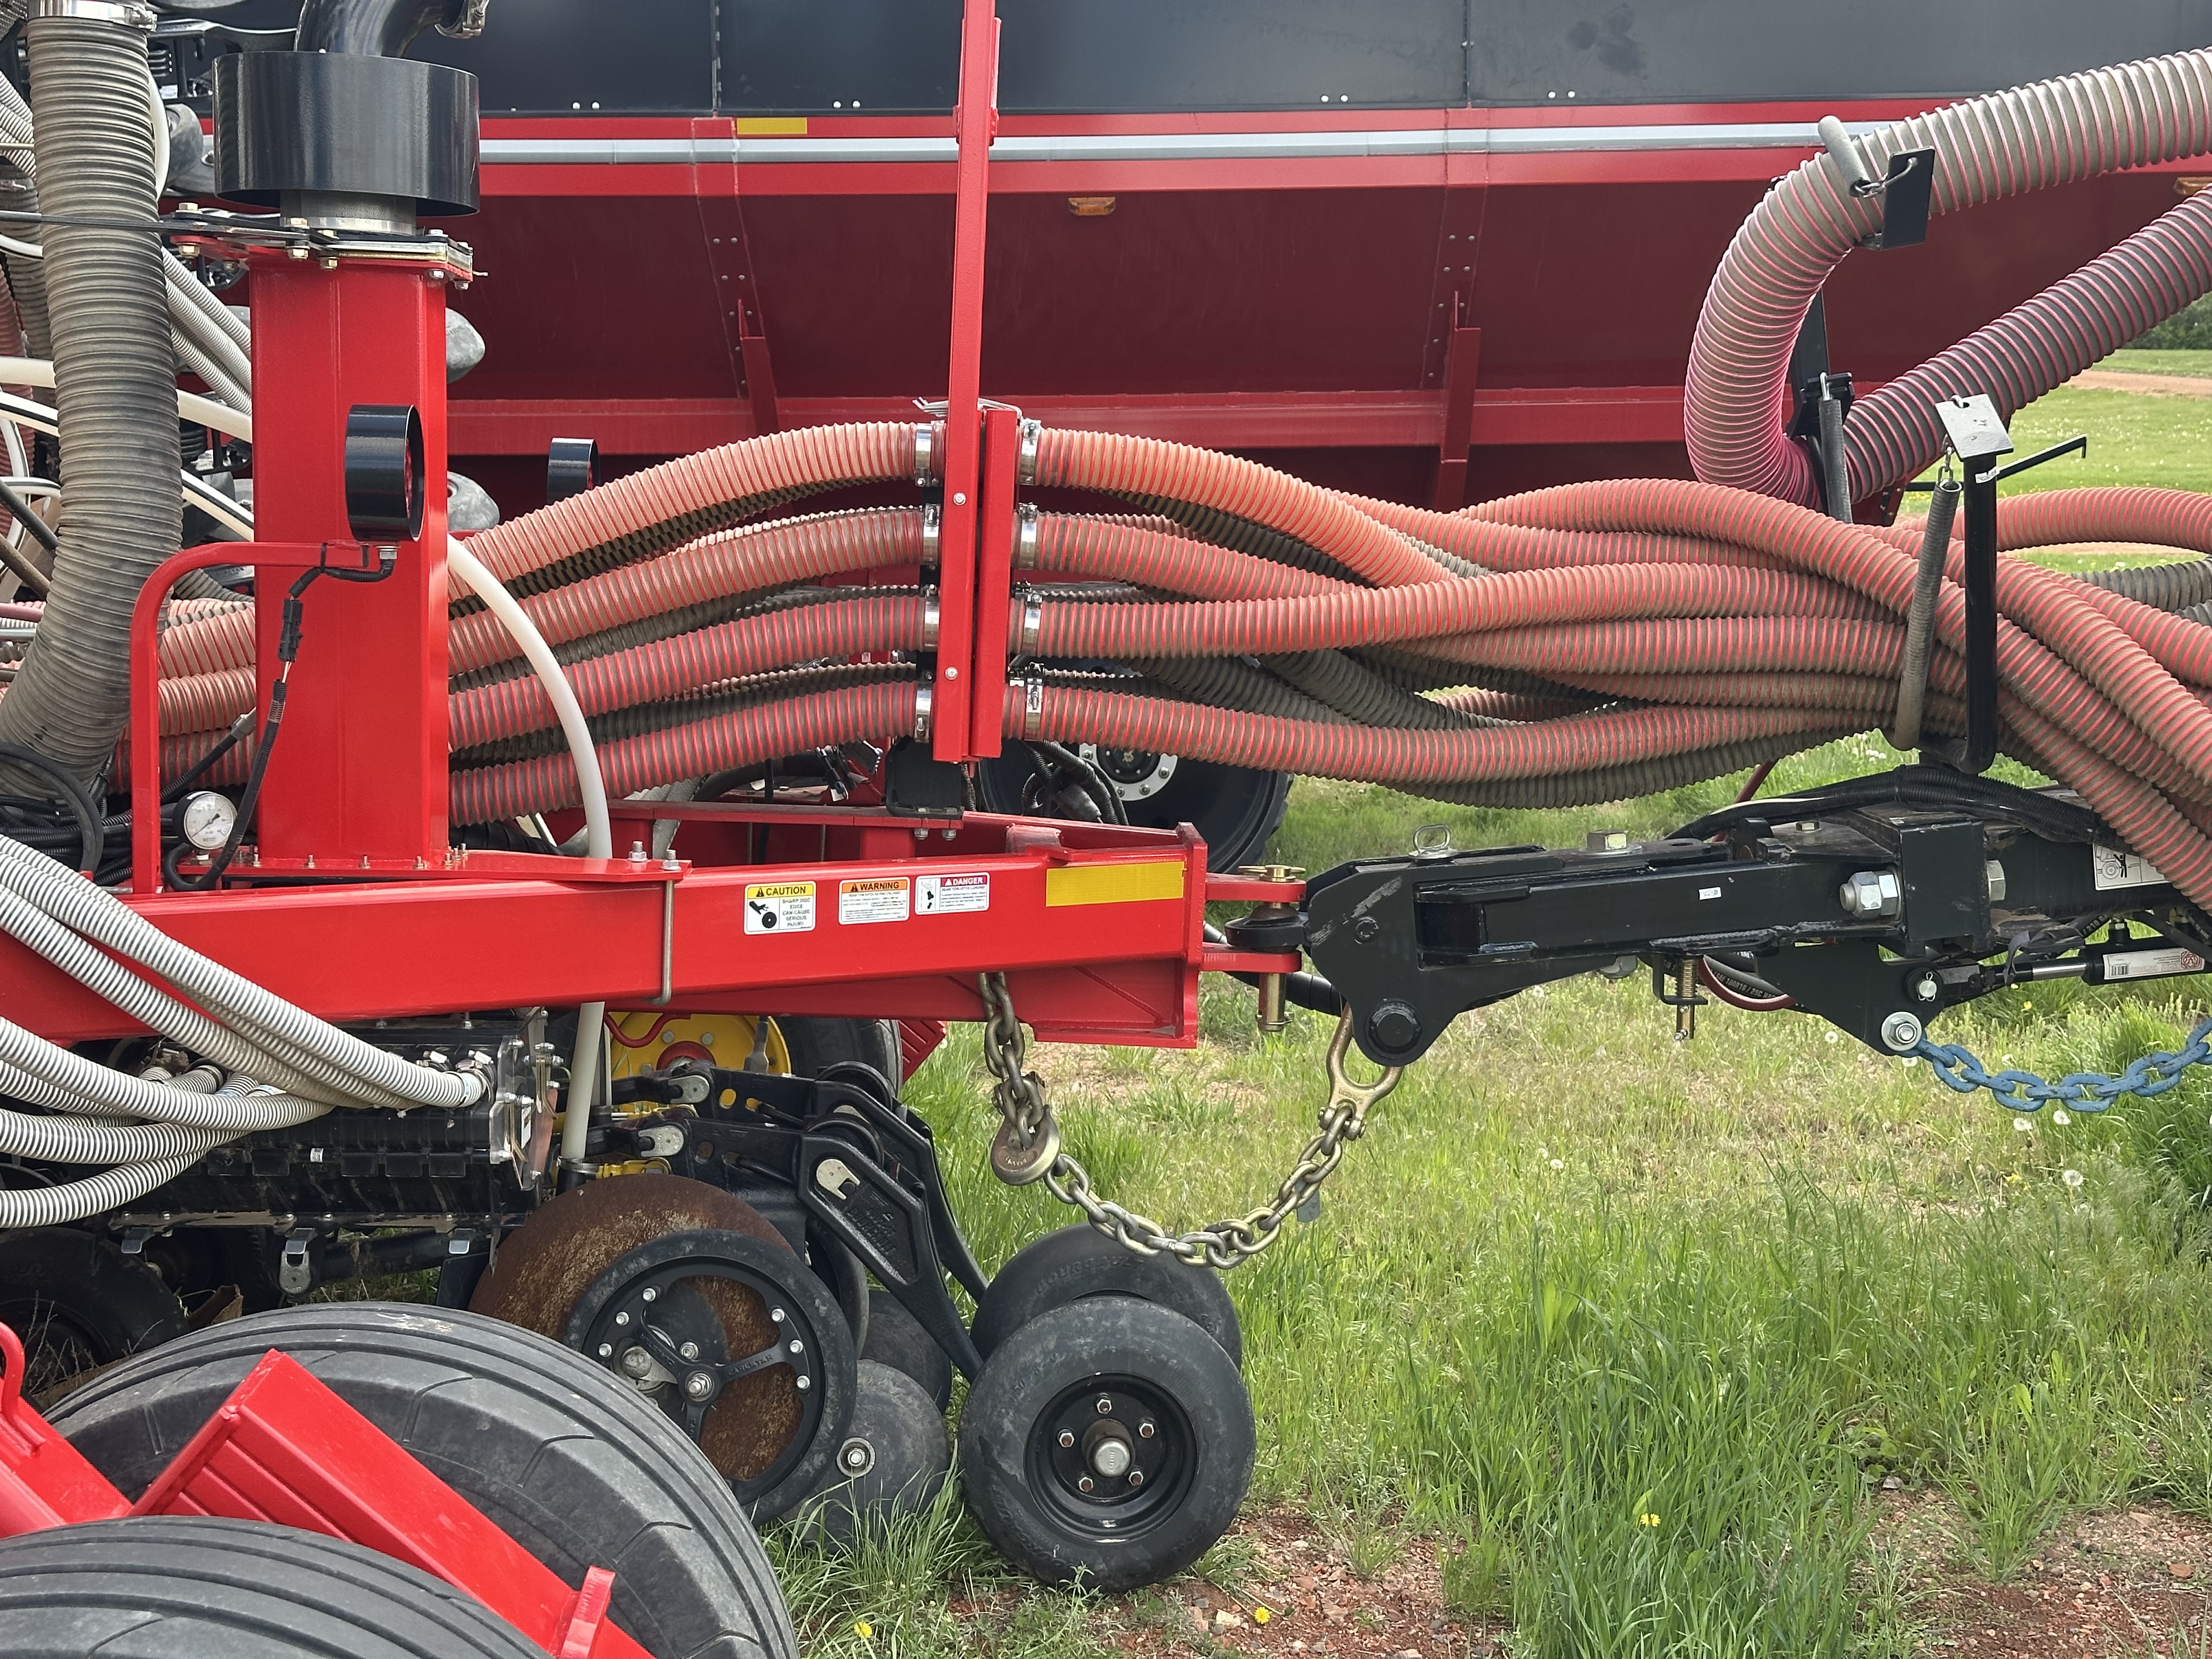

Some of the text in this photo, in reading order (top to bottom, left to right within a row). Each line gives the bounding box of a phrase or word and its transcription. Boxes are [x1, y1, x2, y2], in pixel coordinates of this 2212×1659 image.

[953, 877, 983, 885] DANGER
[860, 882, 899, 890] WARNING
[766, 886, 806, 895] CAUTION
[2086, 919, 2100, 932] 210
